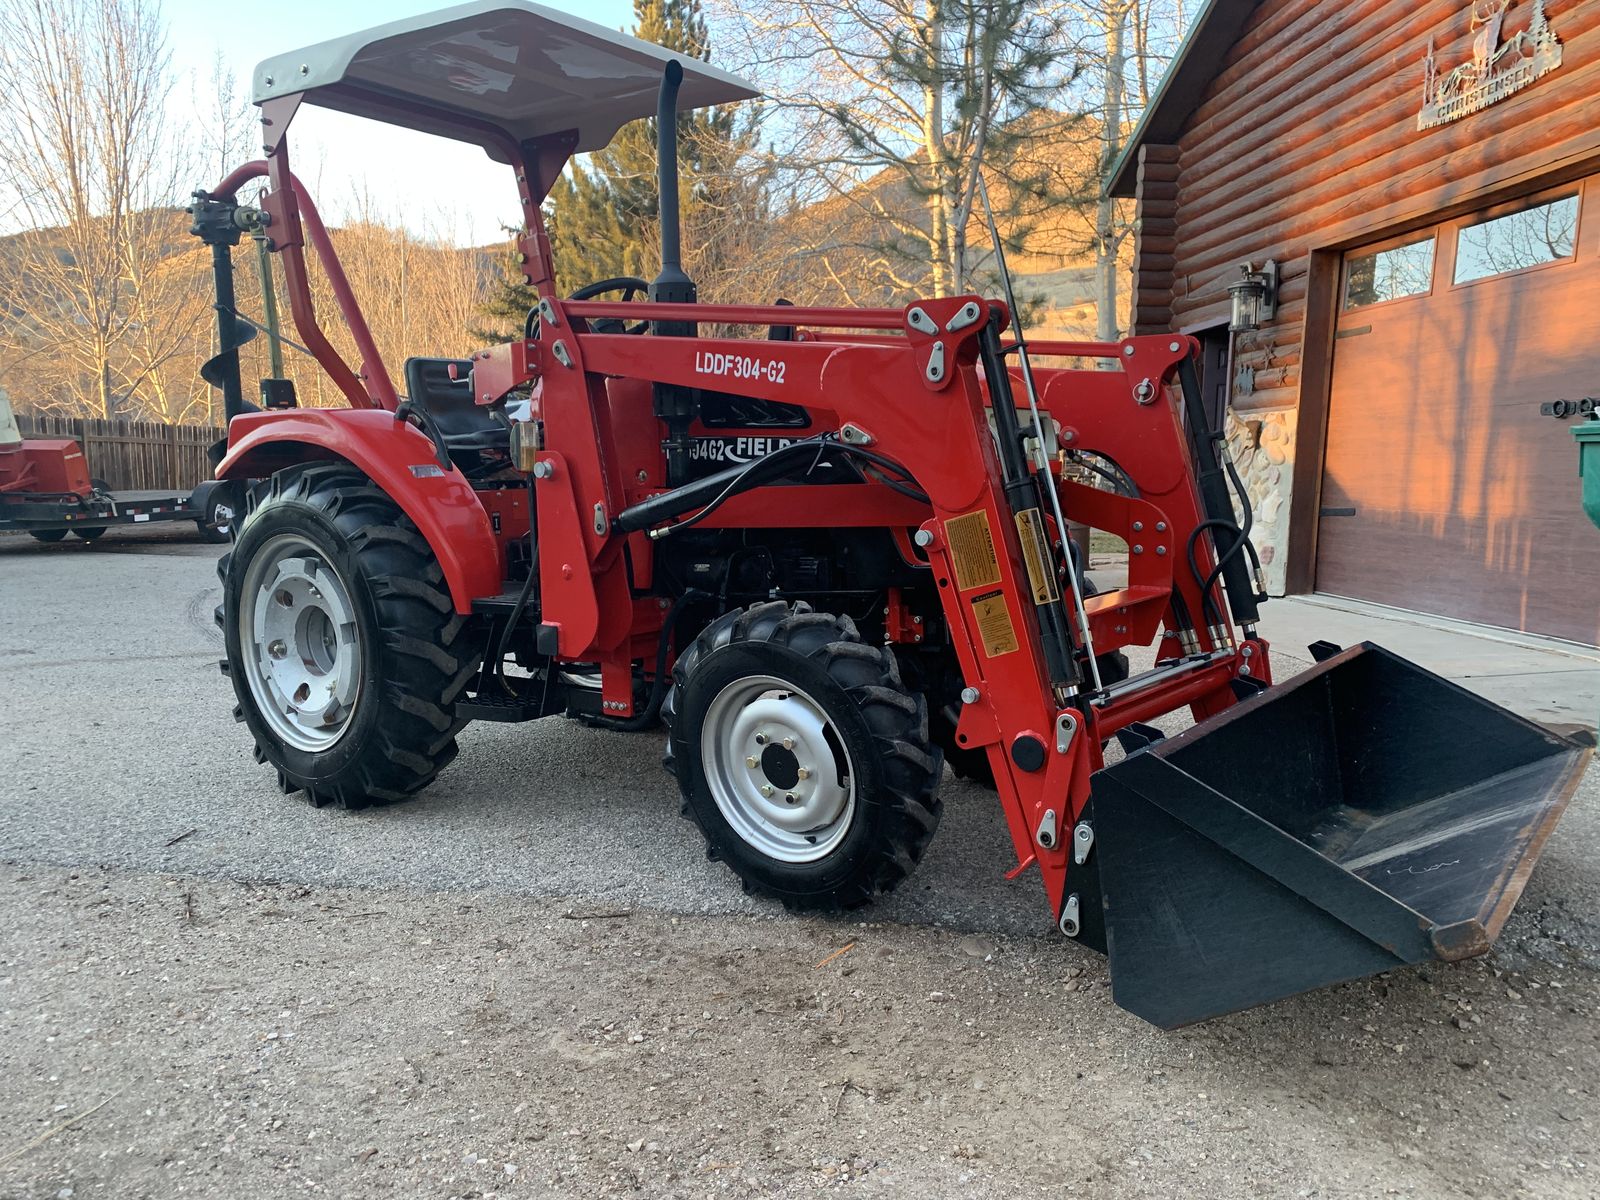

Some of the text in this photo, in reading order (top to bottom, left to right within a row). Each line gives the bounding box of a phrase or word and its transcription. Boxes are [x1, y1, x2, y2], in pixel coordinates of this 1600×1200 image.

[1437, 64, 1534, 119] CHRISTENSEN
[695, 351, 786, 384] LDDF304-G2
[984, 527, 997, 564] ATTENTION
